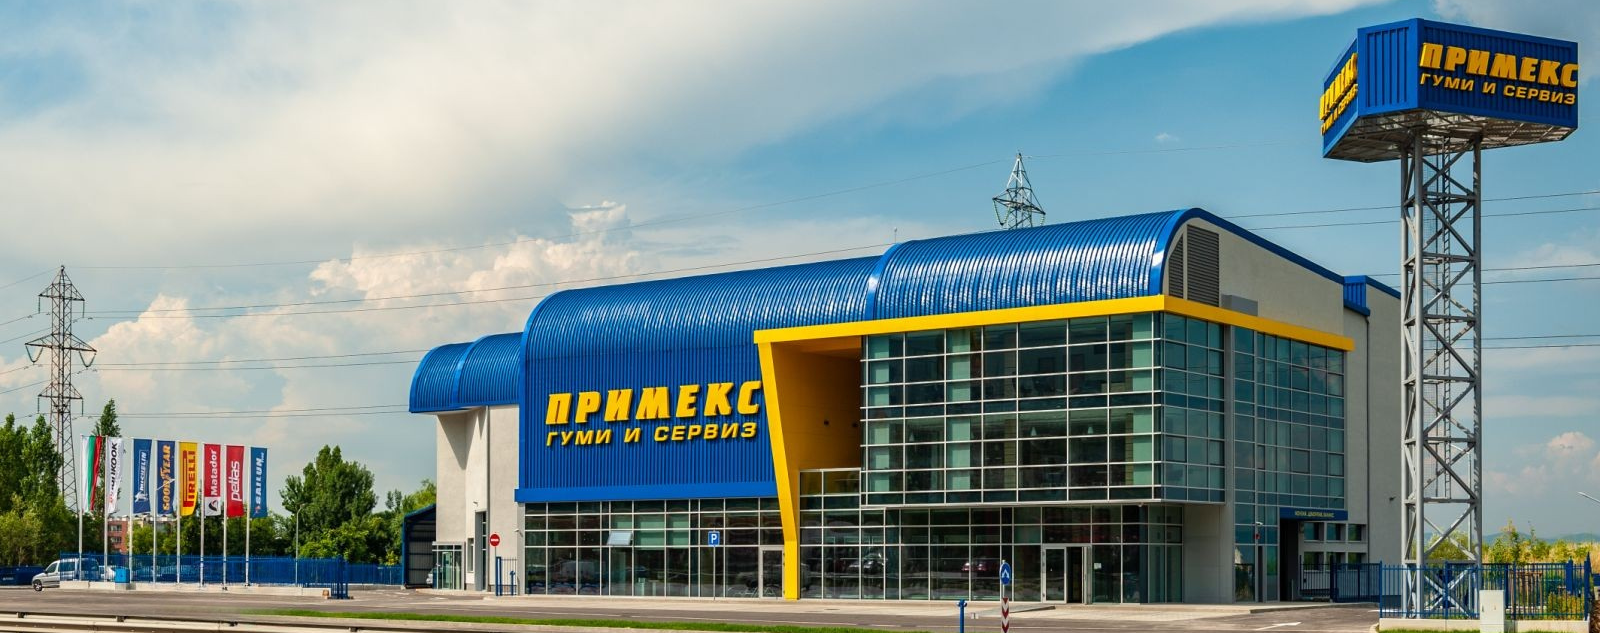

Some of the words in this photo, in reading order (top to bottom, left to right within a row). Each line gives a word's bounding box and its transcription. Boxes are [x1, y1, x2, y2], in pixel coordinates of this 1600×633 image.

[1419, 42, 1579, 88] ПРИМЕКС
[1420, 73, 1474, 92] ГУМИ
[1482, 82, 1496, 94] И
[1503, 85, 1576, 105] СЕРВИЗ
[545, 380, 762, 425] ПРИМЕКС
[546, 429, 612, 446] ГУМИ
[624, 427, 641, 443] И
[654, 422, 757, 442] СЕРВИЗ
[161, 445, 171, 511] GOODYEAR
[183, 450, 196, 508] PIRELLI
[210, 447, 218, 496] Matador
[228, 460, 243, 502] petlas
[255, 457, 263, 505] SAILUN
[711, 533, 718, 544] P
